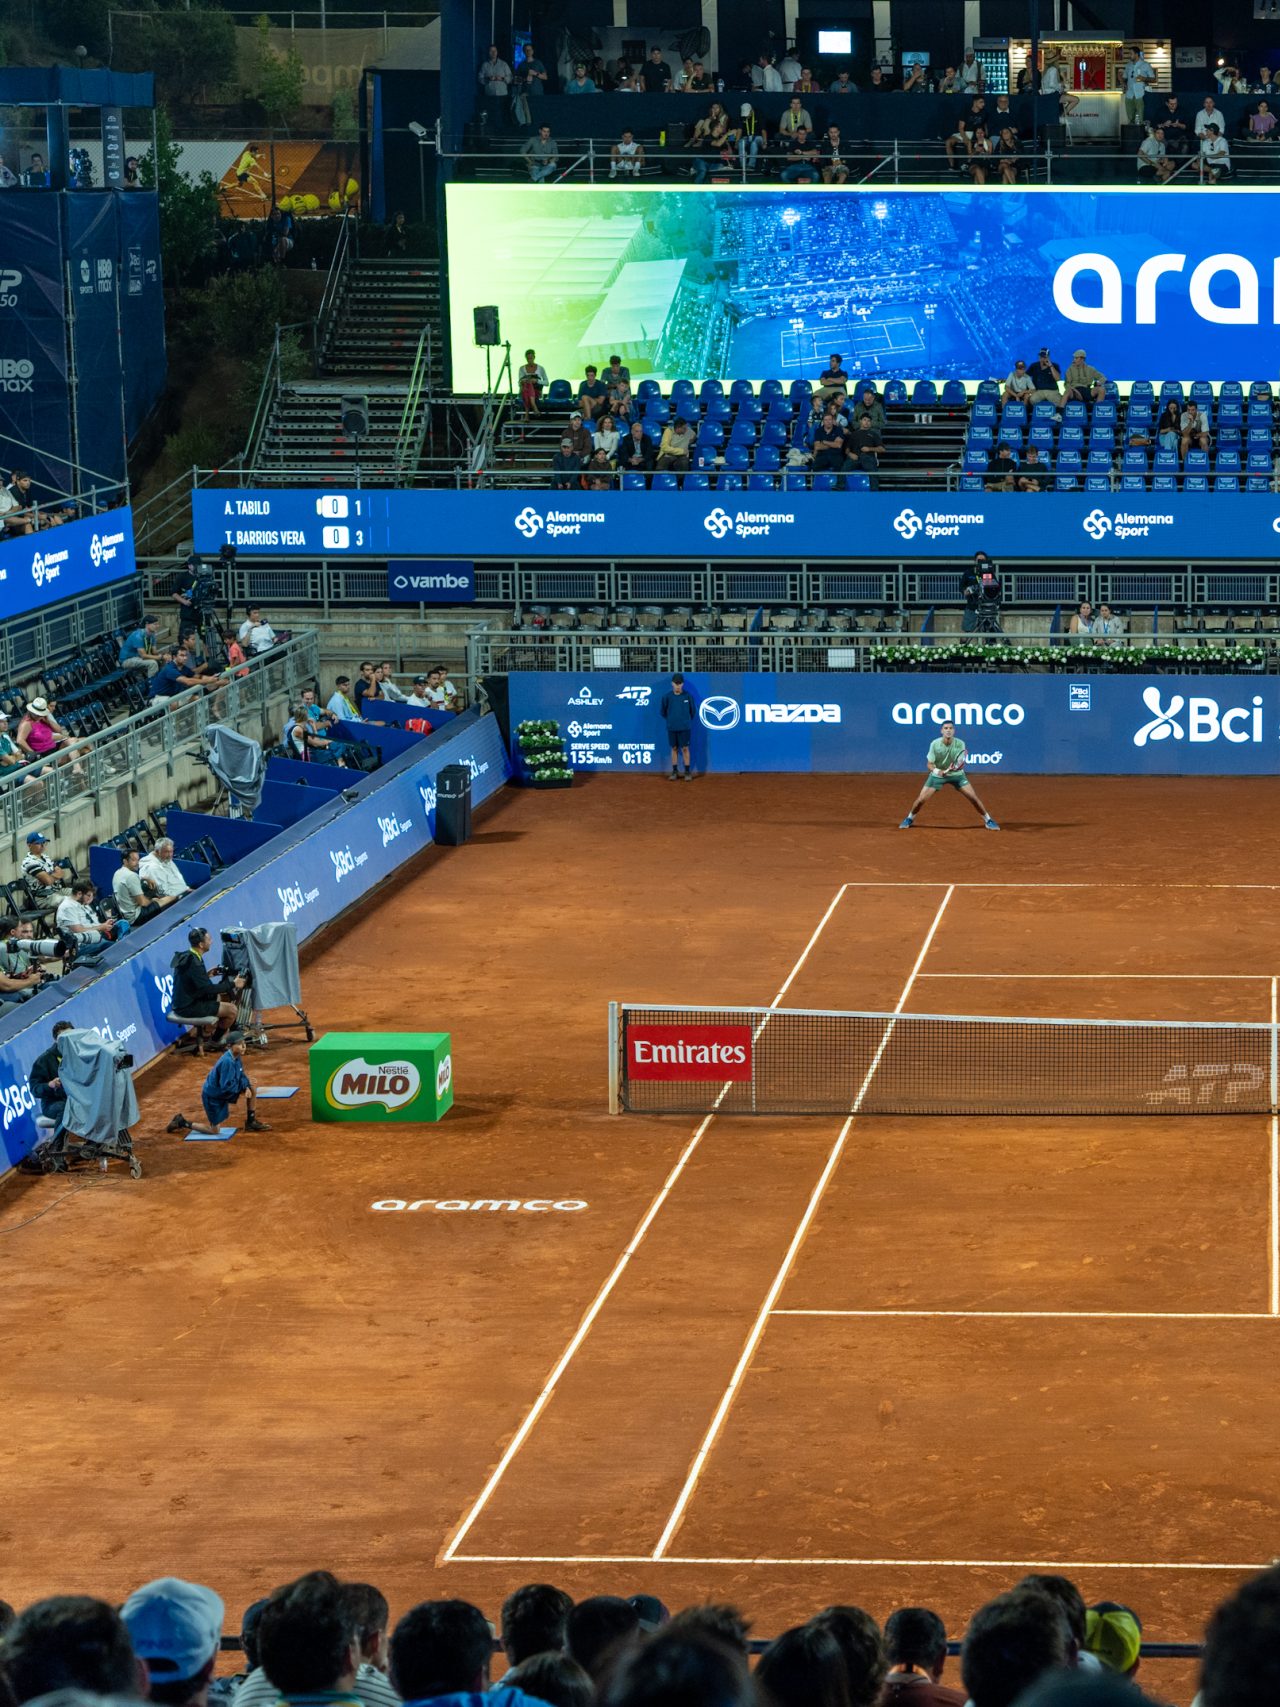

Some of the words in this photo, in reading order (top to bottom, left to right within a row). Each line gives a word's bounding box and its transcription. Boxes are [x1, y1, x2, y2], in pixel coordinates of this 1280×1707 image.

[224, 501, 235, 515] A.
[236, 501, 270, 515] TABILO
[332, 499, 339, 515] 0
[355, 500, 362, 516] 1
[546, 511, 605, 523] Alemana
[735, 511, 794, 523] Alemana
[925, 512, 984, 524] Alemana
[1114, 512, 1173, 524] Alemana
[225, 531, 233, 545] T.
[237, 531, 279, 545] BARRIOS
[280, 531, 306, 545] VERA
[333, 529, 340, 544] 0
[356, 530, 363, 546] 3
[546, 523, 581, 538] Sport
[735, 523, 770, 538] Sport
[925, 524, 960, 539] Sport
[1114, 524, 1149, 539] Sport
[102, 532, 125, 547] Alemana
[45, 550, 69, 566] Alemana
[103, 547, 117, 564] Sport
[46, 565, 60, 583] Sport
[409, 573, 469, 588] vambe
[615, 686, 652, 699] ATP
[567, 697, 604, 706] ASHLEY
[745, 703, 841, 723] mazda
[892, 702, 1025, 726] aramco
[1190, 696, 1263, 743] Bci
[583, 730, 601, 738] Sport
[570, 743, 590, 751] SERVE
[591, 743, 610, 751] SPEED
[618, 743, 640, 751] MATCH
[641, 743, 655, 751] TIME
[622, 751, 652, 765] 0:18
[116, 1022, 138, 1043] Seguros
[634, 1040, 746, 1064] Emirates
[340, 1073, 410, 1095] MILO
[1137, 1063, 1265, 1105] ATP
[370, 1198, 590, 1213] aramco
